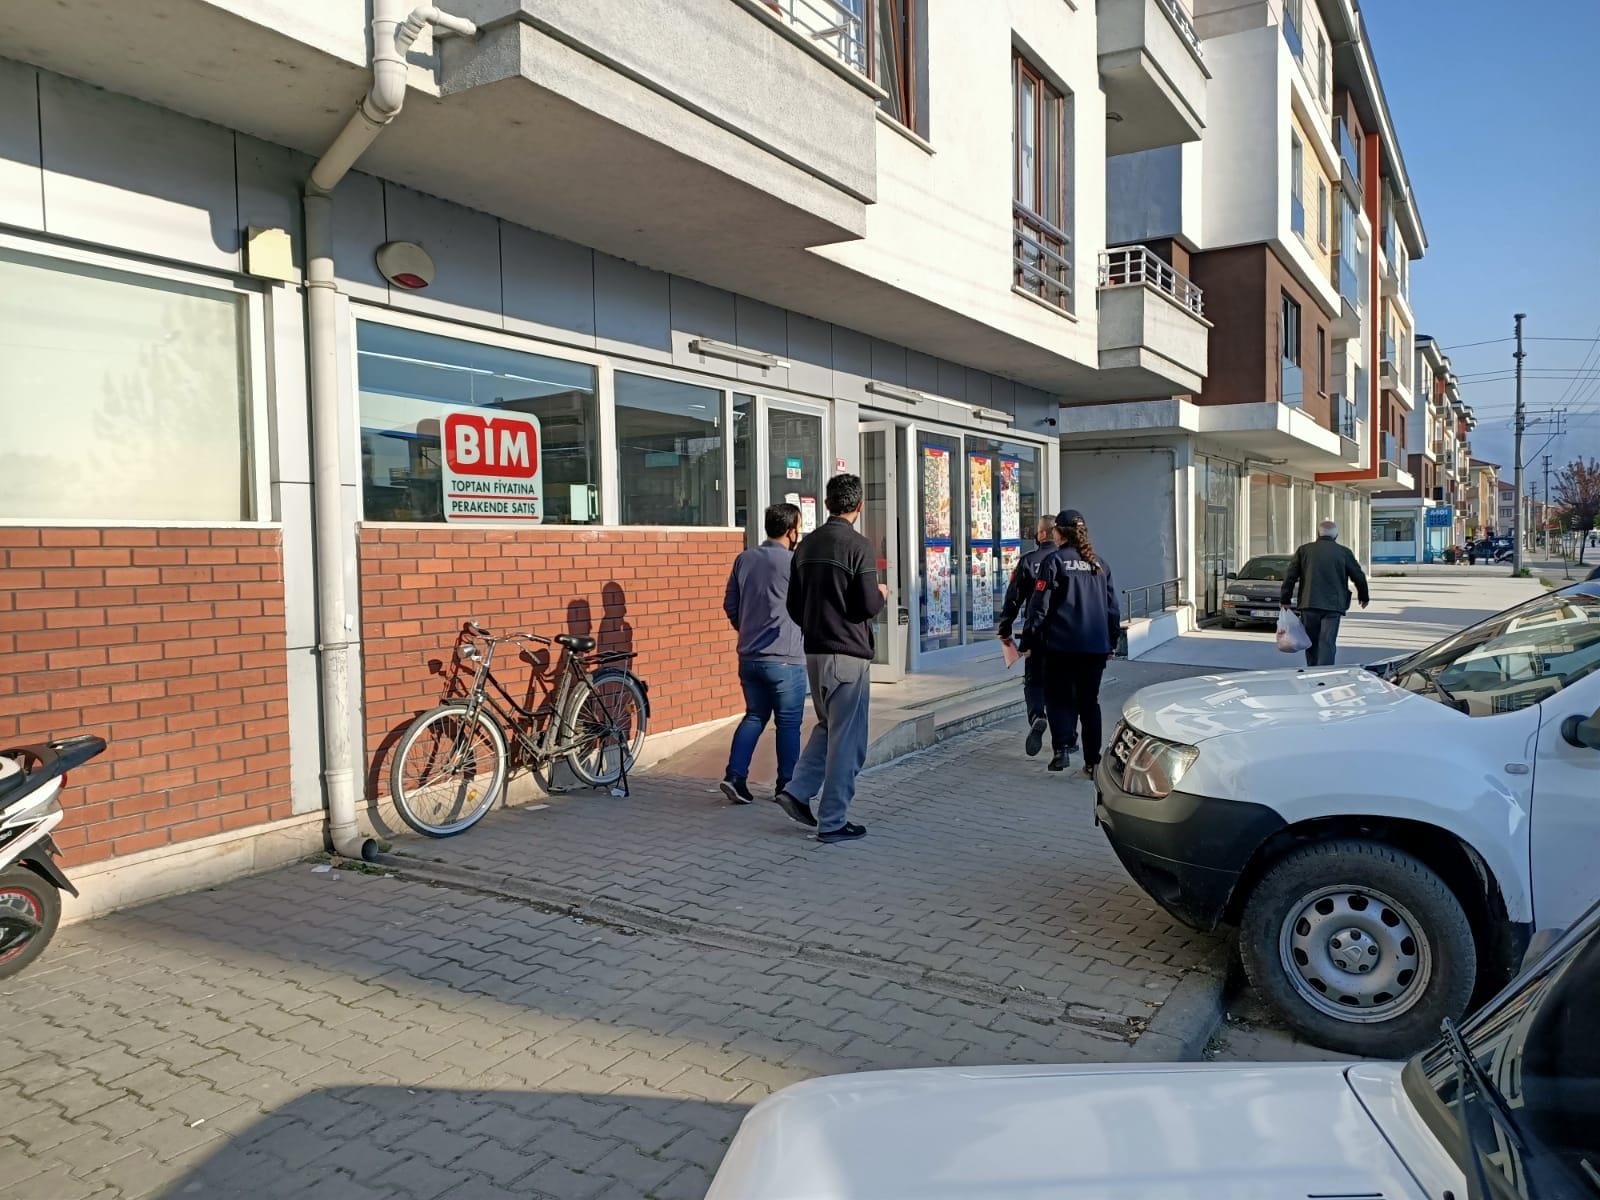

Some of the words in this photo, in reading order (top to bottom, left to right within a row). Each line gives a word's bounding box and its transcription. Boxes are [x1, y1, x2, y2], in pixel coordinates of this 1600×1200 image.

[451, 480, 490, 493] TOPTAN
[452, 501, 508, 513] PERAKENDE
[511, 502, 536, 515] SATIŞ
